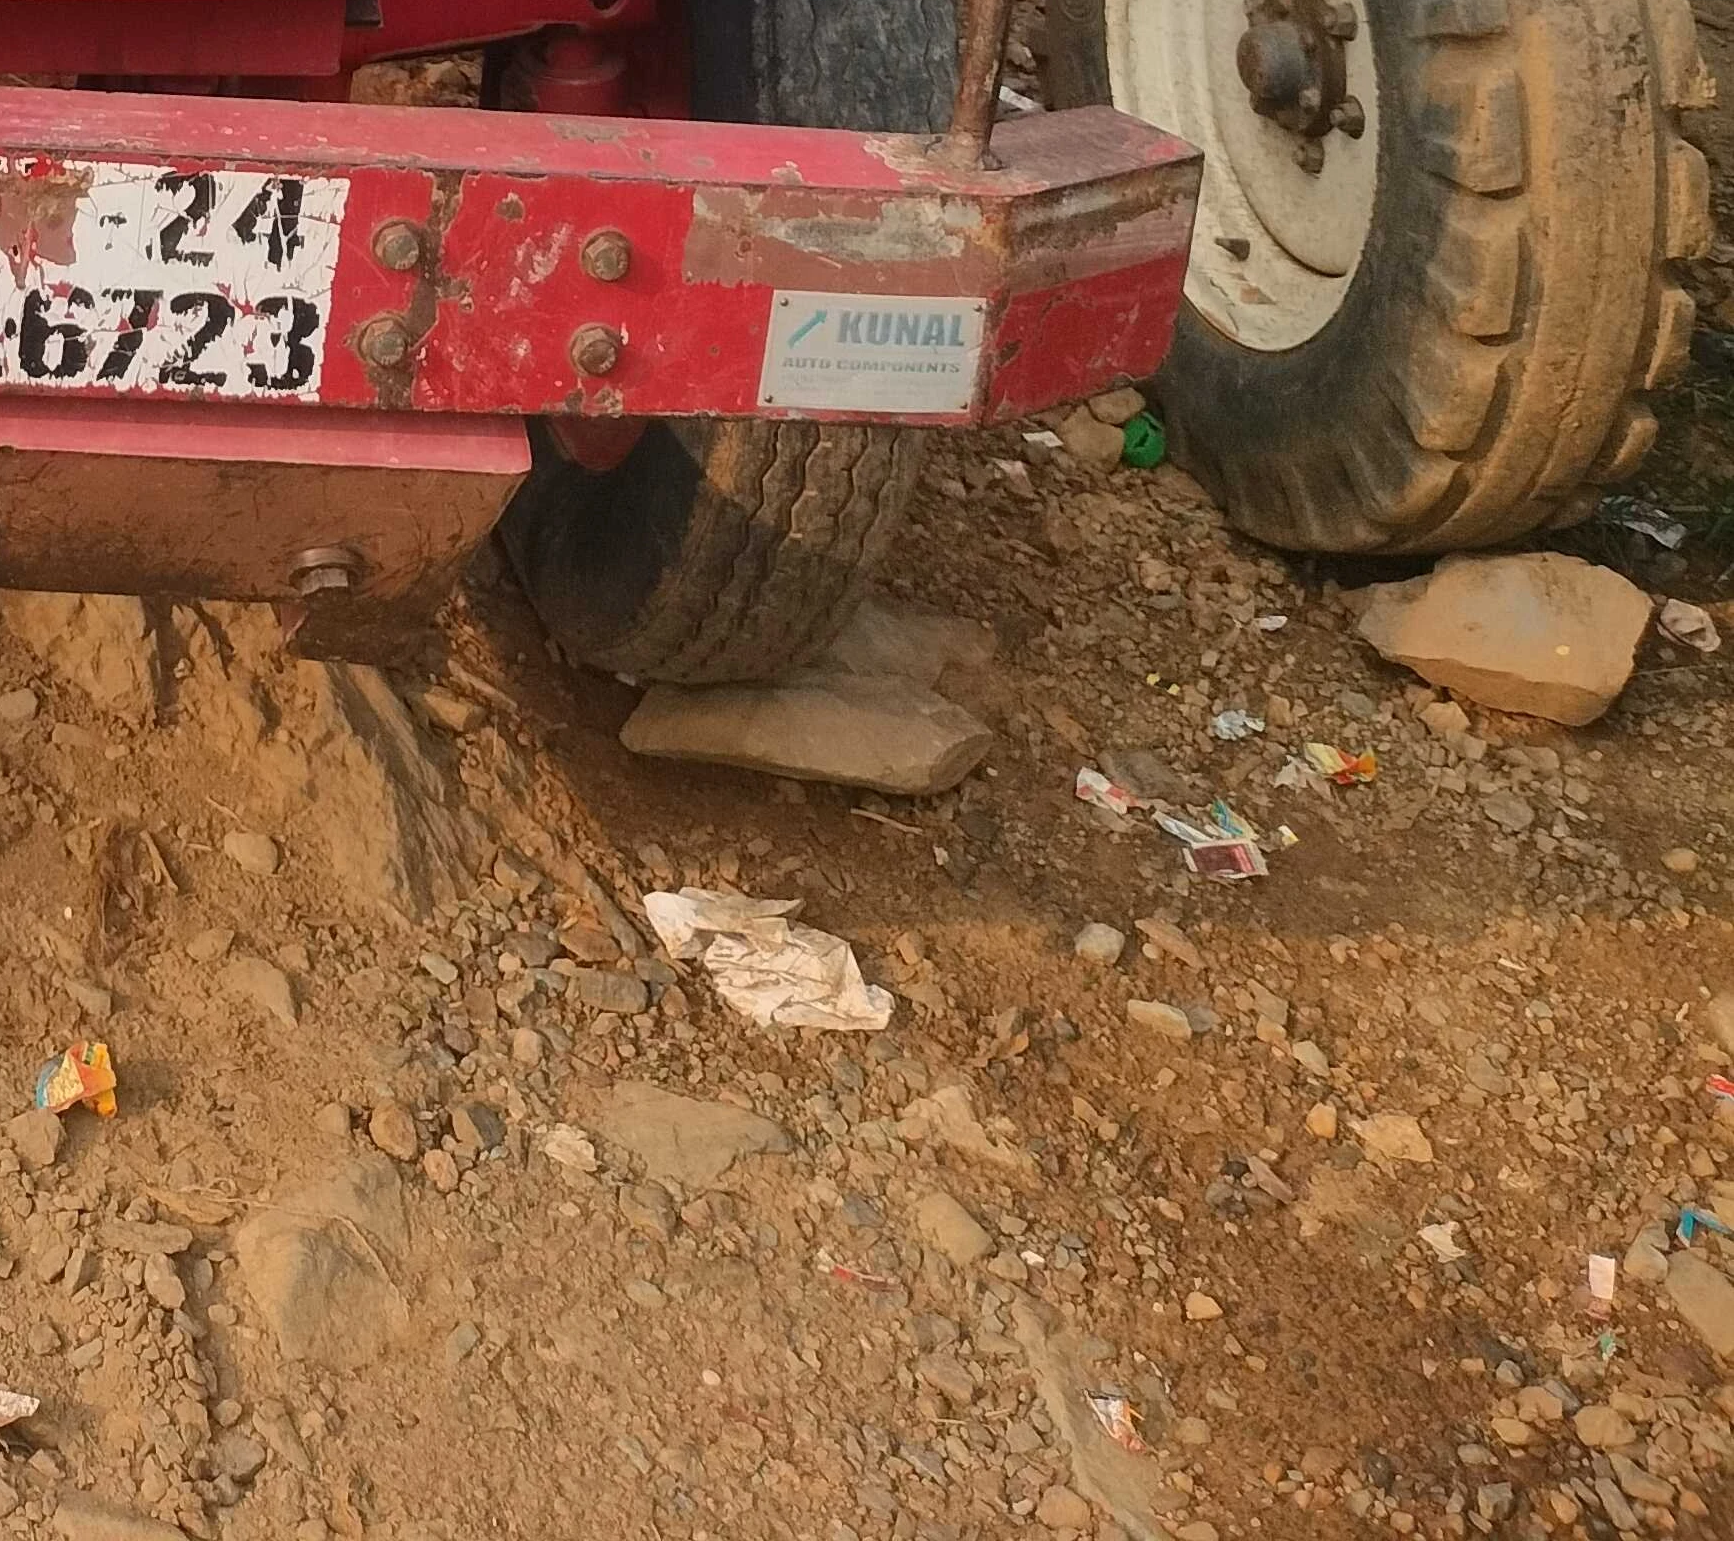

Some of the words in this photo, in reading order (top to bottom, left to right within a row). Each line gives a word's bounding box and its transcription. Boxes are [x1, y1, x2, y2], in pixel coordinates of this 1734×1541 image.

[837, 310, 965, 347] KUNAL
[782, 357, 831, 370] AUTO
[836, 360, 961, 374] COMPONENTS
